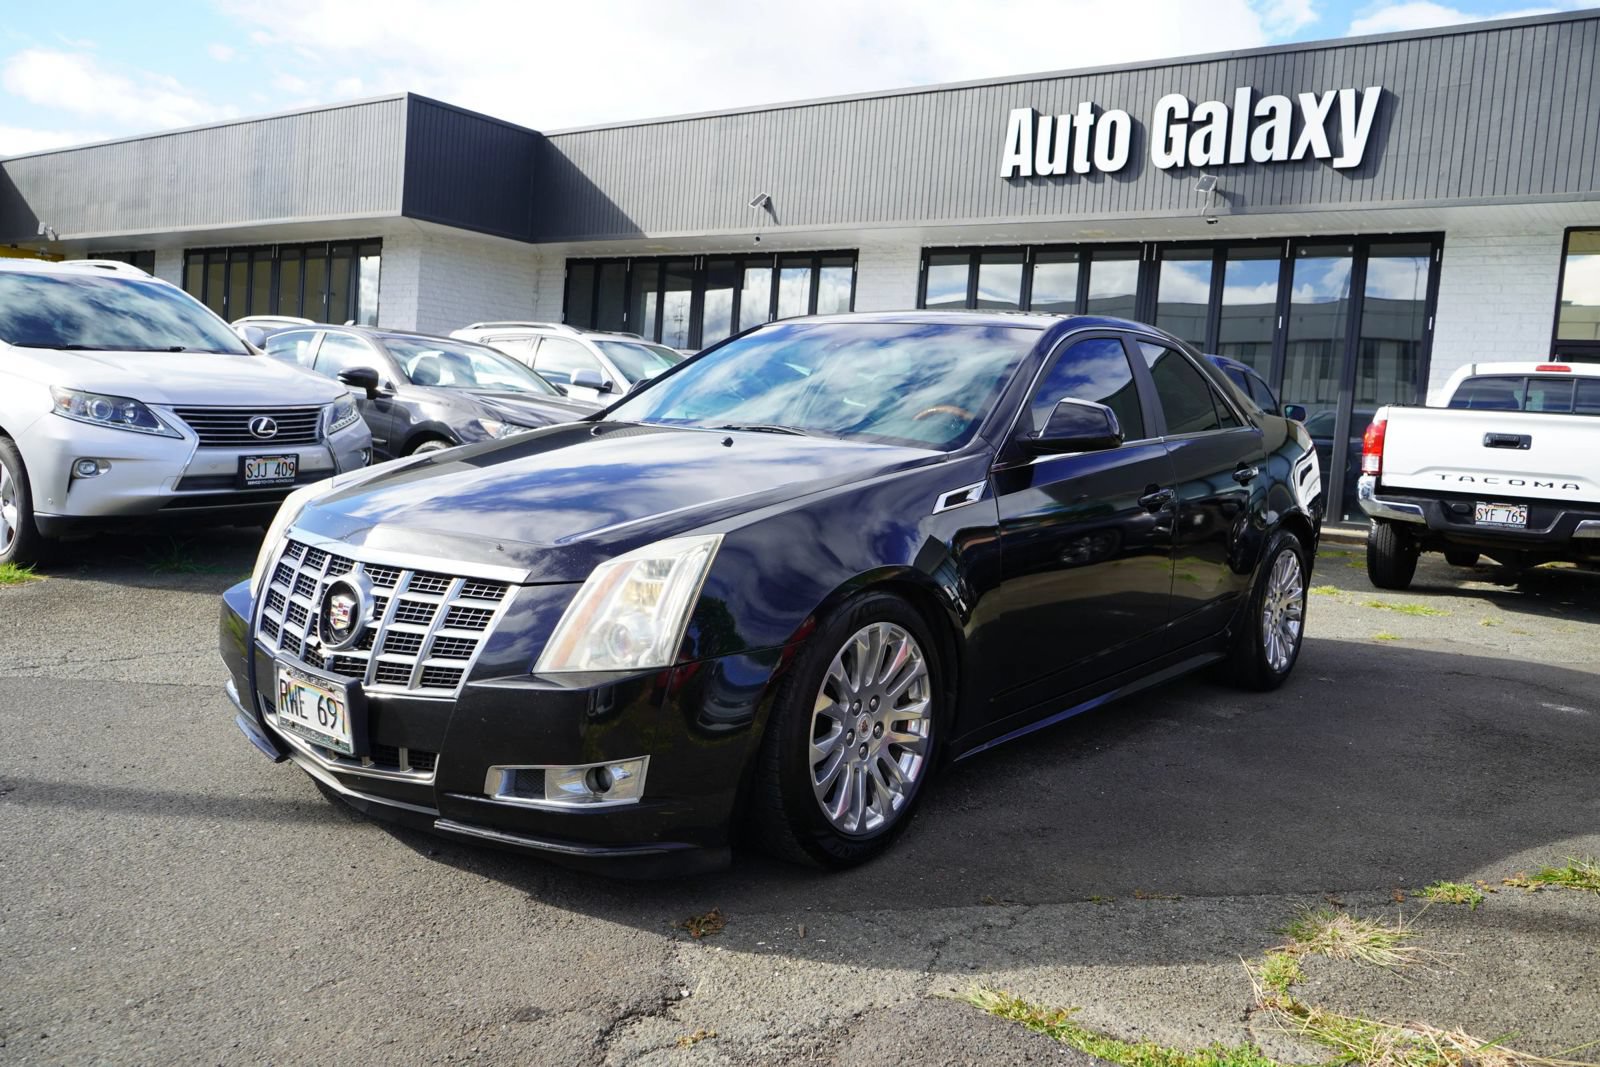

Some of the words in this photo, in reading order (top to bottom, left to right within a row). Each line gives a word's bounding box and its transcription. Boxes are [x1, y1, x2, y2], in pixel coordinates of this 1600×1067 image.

[1000, 102, 1132, 178] Auto
[1151, 86, 1384, 170] Galaxy
[246, 462, 268, 479] SJJ
[274, 461, 296, 477] 409
[1435, 473, 1581, 491] TACOMA
[1476, 507, 1498, 521] SYF
[1505, 509, 1526, 524] 765
[279, 678, 308, 720] RWE
